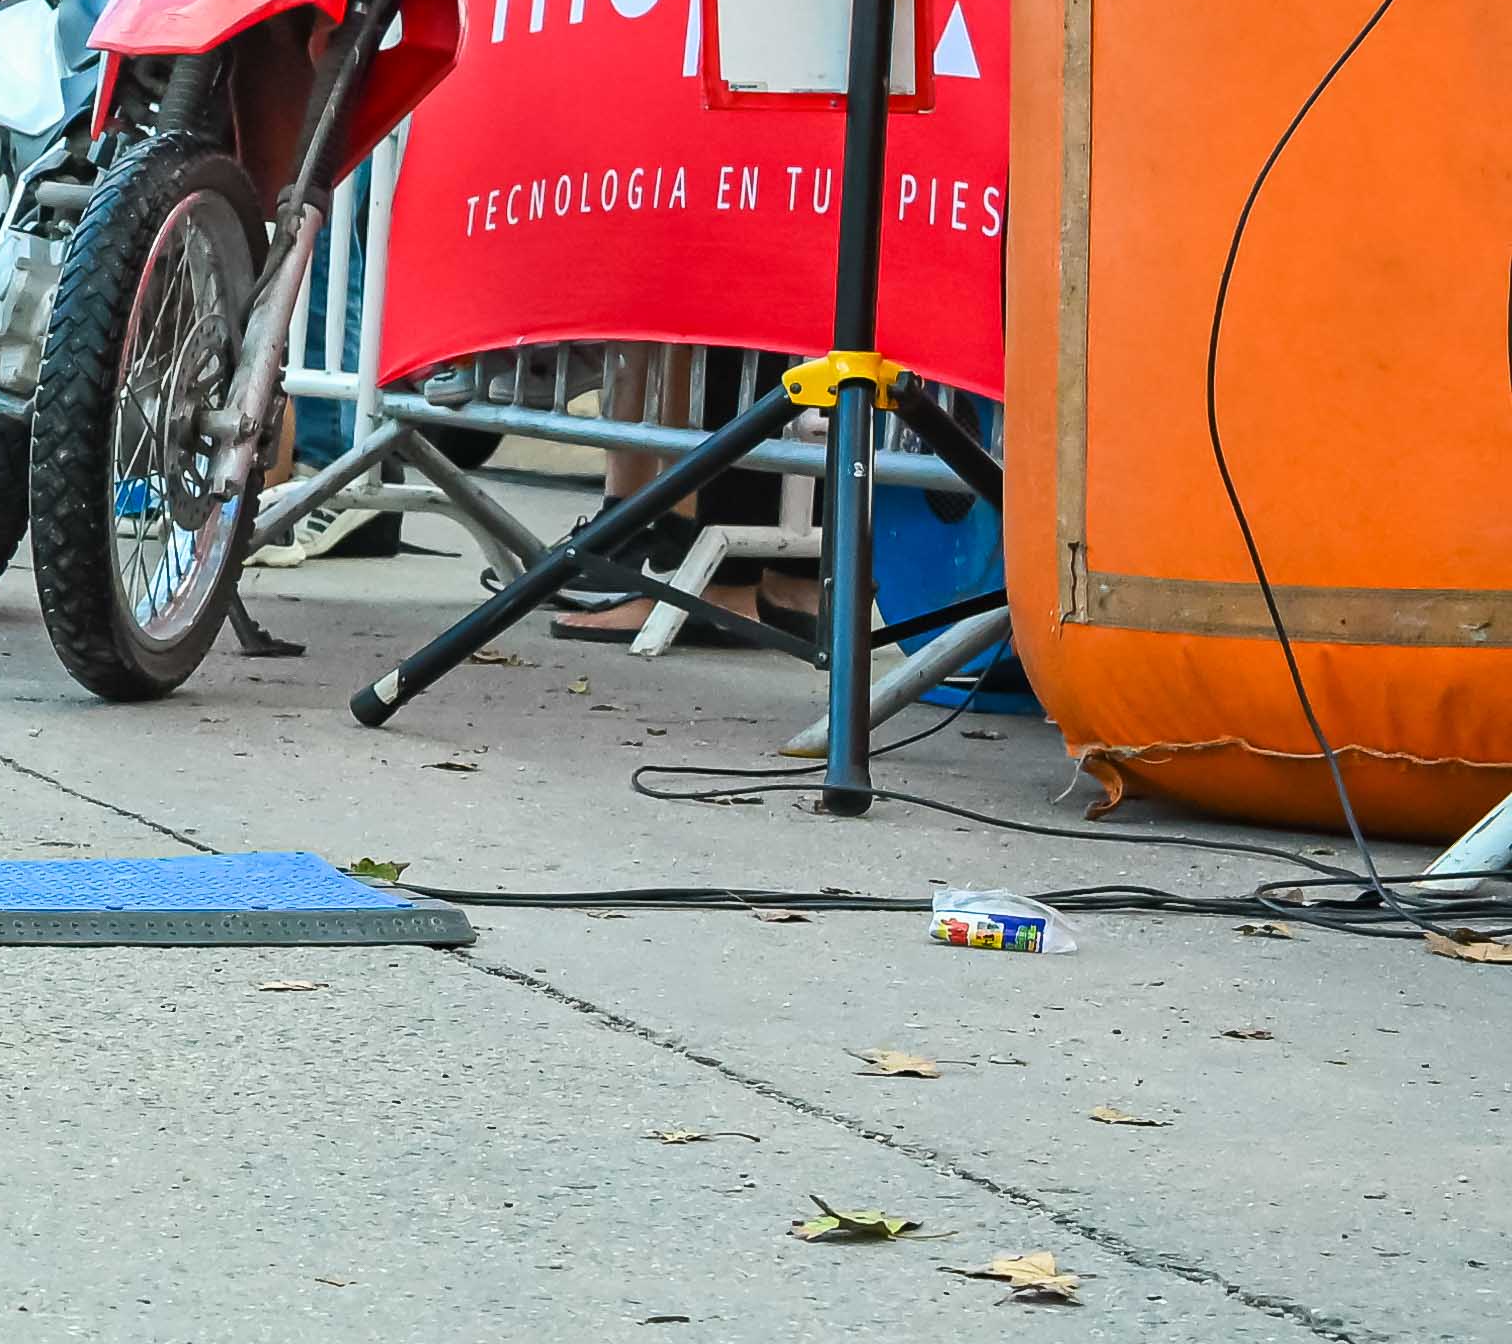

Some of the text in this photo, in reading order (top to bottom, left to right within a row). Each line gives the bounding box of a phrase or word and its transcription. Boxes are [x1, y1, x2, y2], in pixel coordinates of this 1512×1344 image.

[466, 166, 1001, 237] TECNOLOGIA EN TU PIES
